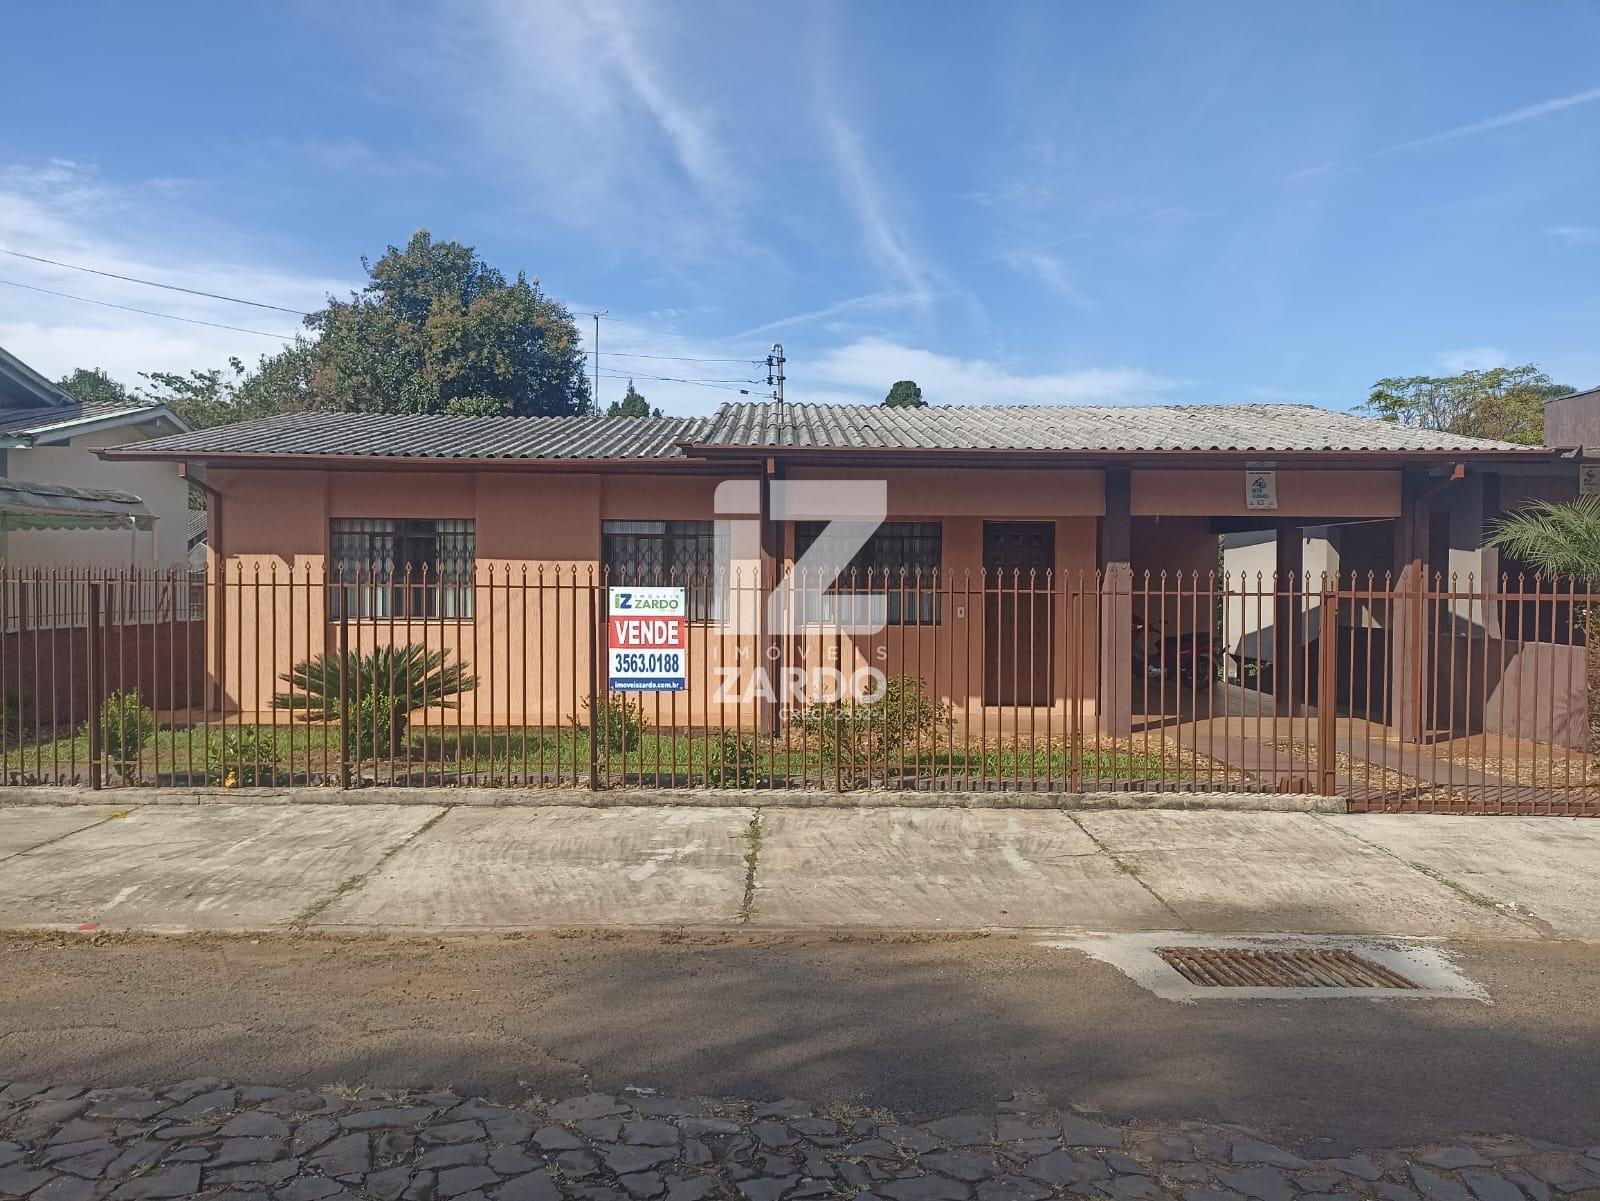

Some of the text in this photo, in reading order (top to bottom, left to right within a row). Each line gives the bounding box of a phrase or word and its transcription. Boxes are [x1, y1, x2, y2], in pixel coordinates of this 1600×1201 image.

[634, 599, 679, 609] ZARDO
[615, 620, 679, 645] VENDE
[615, 653, 679, 673] 3563.0188
[615, 681, 679, 689] imoveiszardo.com.br
